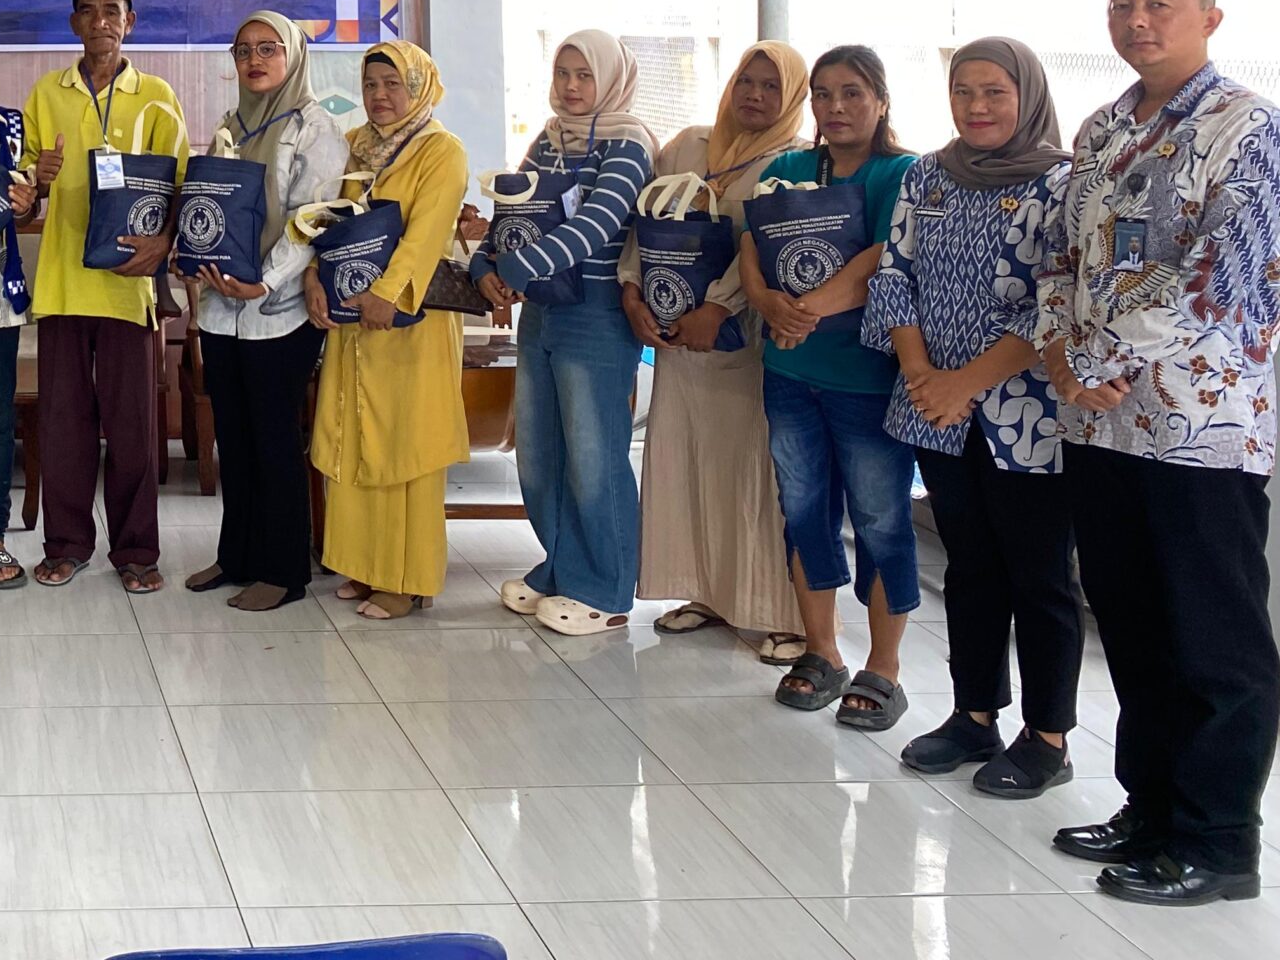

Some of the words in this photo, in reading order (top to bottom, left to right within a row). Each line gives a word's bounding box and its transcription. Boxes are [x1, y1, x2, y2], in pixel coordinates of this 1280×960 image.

[779, 239, 801, 261] TAHANAN
[802, 239, 828, 250] NEGARA
[827, 246, 841, 265] KELAS
